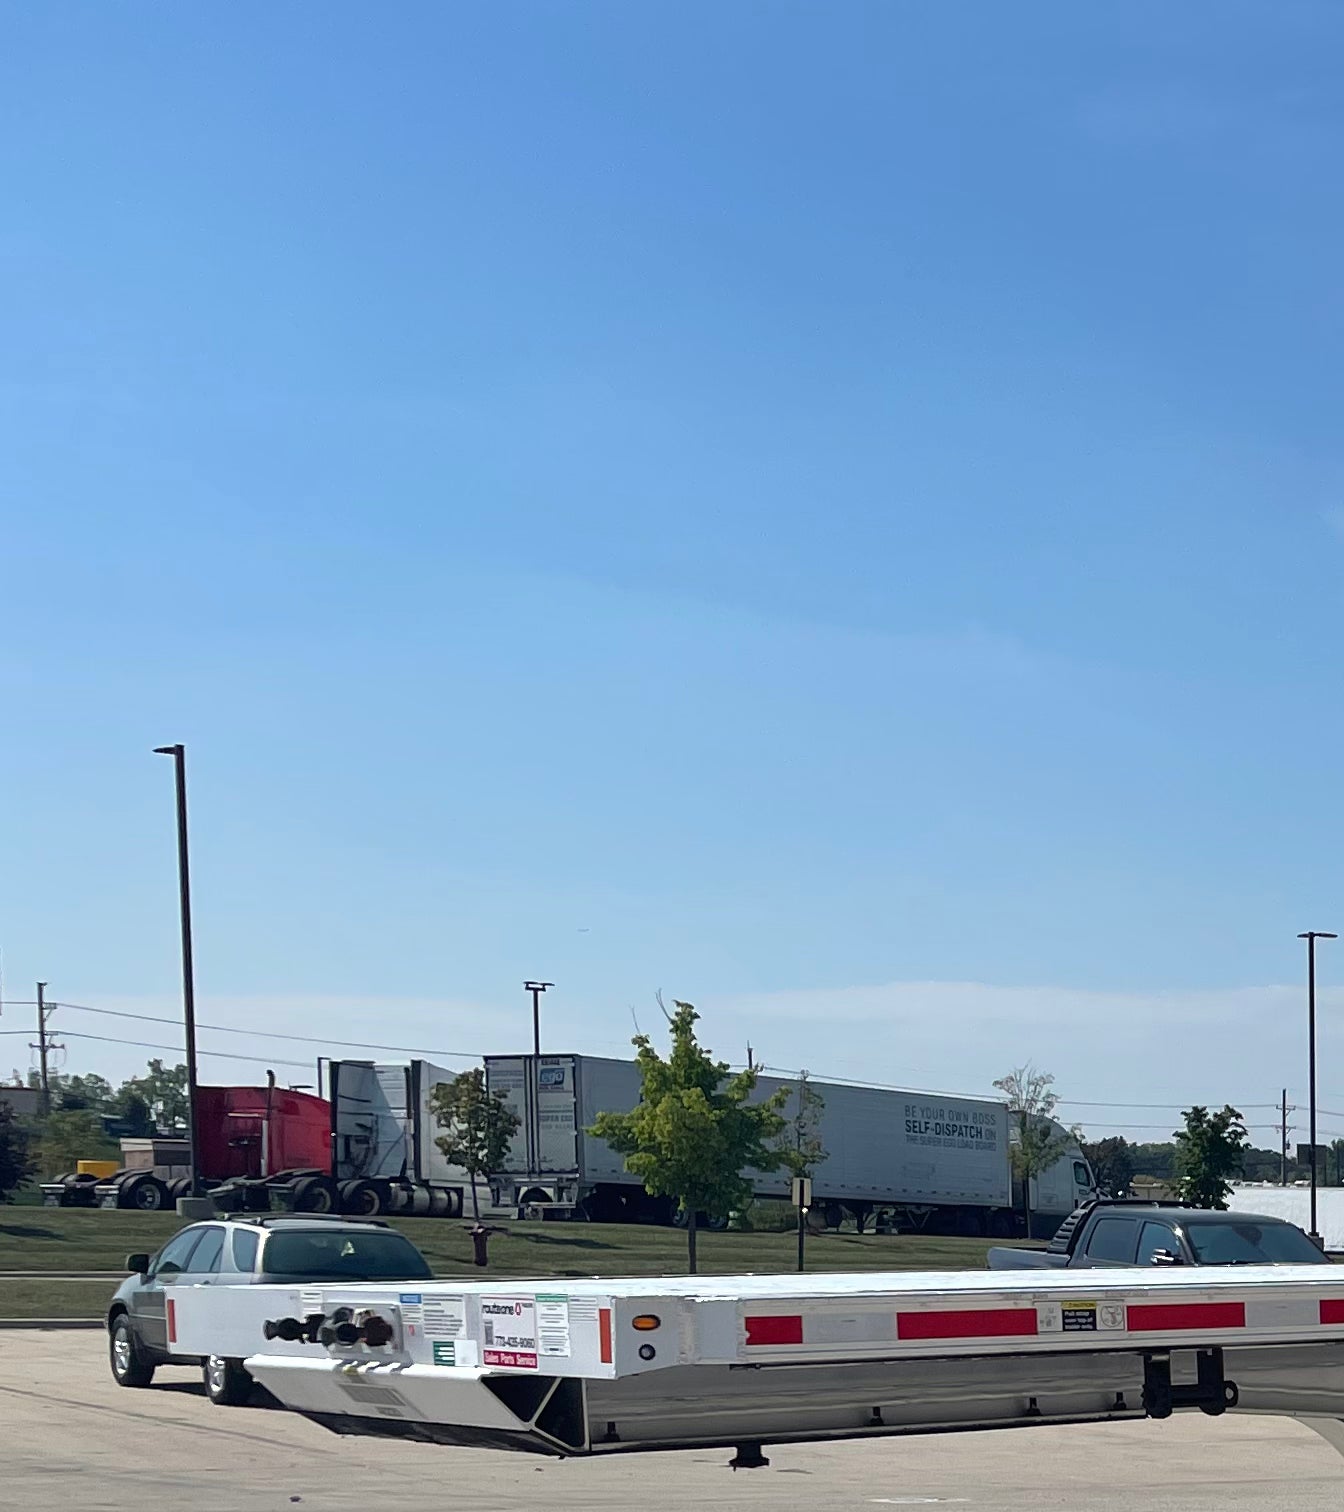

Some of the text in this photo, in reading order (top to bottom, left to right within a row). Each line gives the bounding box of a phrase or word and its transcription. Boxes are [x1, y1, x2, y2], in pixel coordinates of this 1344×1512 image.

[904, 1105, 996, 1126] BE YOUR OWN BOSS
[905, 1119, 996, 1140] SELF-DISPATCH ON
[905, 1134, 919, 1144] THE
[500, 1353, 515, 1365] Parts
